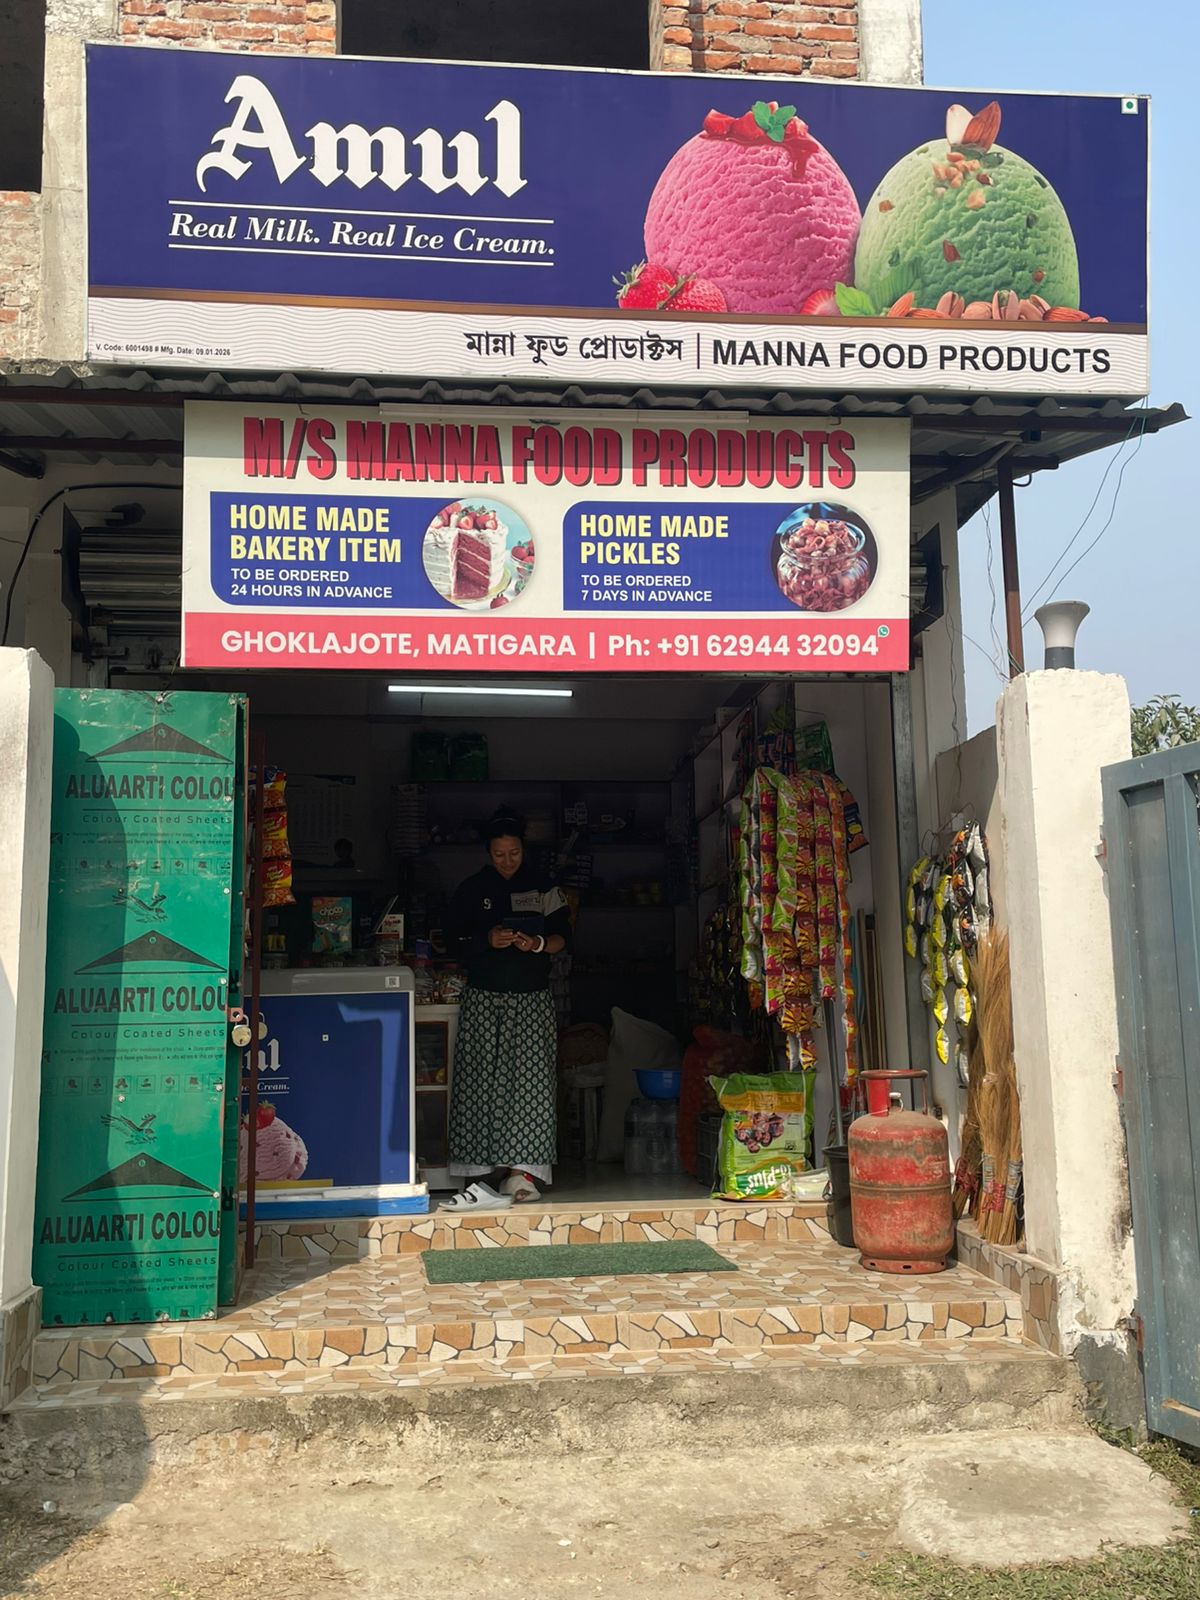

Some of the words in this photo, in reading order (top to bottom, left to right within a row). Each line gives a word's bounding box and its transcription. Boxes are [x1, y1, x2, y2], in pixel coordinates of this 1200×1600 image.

[196, 74, 528, 198] Amul
[168, 212, 236, 240] Real
[244, 216, 320, 244] Milk.
[329, 221, 395, 248] Real
[401, 224, 443, 250] Ice
[454, 227, 555, 256] Cream.
[103, 343, 123, 352] Code:
[177, 346, 194, 355] Date:
[463, 330, 516, 357] মান্না
[524, 334, 568, 366] ফুড
[712, 339, 829, 369] MANNA
[840, 342, 930, 371] FOOD
[939, 344, 1111, 374] PRODUCTS
[243, 416, 337, 481] M/S
[346, 420, 504, 484] MANNA
[511, 424, 623, 487] FOOD
[631, 427, 857, 490] PRODUCTS
[230, 504, 306, 531] HOME
[316, 506, 390, 533] MADE
[580, 514, 651, 538] HOME
[660, 515, 729, 538] MADE
[230, 534, 331, 562] BAKERY
[339, 537, 401, 563] ITEM
[580, 542, 680, 566] PICKLES
[231, 568, 251, 581] TO
[255, 568, 275, 582] BE
[279, 569, 349, 583] ORDERED
[581, 574, 600, 586] TO
[604, 574, 622, 586] BE
[625, 574, 692, 587] ORDERED
[231, 584, 248, 597] 24
[251, 584, 303, 598] HOURS
[307, 585, 320, 598] IN
[324, 586, 393, 600] ADVANCE
[581, 589, 588, 601] 7
[592, 589, 630, 602] DAYS
[632, 590, 645, 602] IN
[648, 590, 713, 603] ADVANCE
[220, 630, 420, 658] GHOKLAJOTE,
[427, 633, 576, 656] MATIGARA
[608, 634, 650, 657] Ph:
[657, 635, 699, 657] +91
[706, 635, 790, 657] 62944
[797, 635, 878, 657] 32094
[65, 774, 164, 800] ALUAARTI
[82, 814, 127, 824] Colour
[133, 815, 180, 824] Coated
[187, 815, 232, 825] Sheets
[53, 986, 155, 1014] ALUAARTI
[71, 1030, 117, 1040] Colour
[123, 1029, 172, 1039] Coated
[178, 1028, 225, 1038] Sheets
[40, 1213, 144, 1245] ALUAARTI
[151, 1210, 220, 1240] COLOU
[57, 1260, 105, 1272] Colour
[112, 1259, 162, 1270] Coated
[168, 1256, 217, 1267] Sheets
